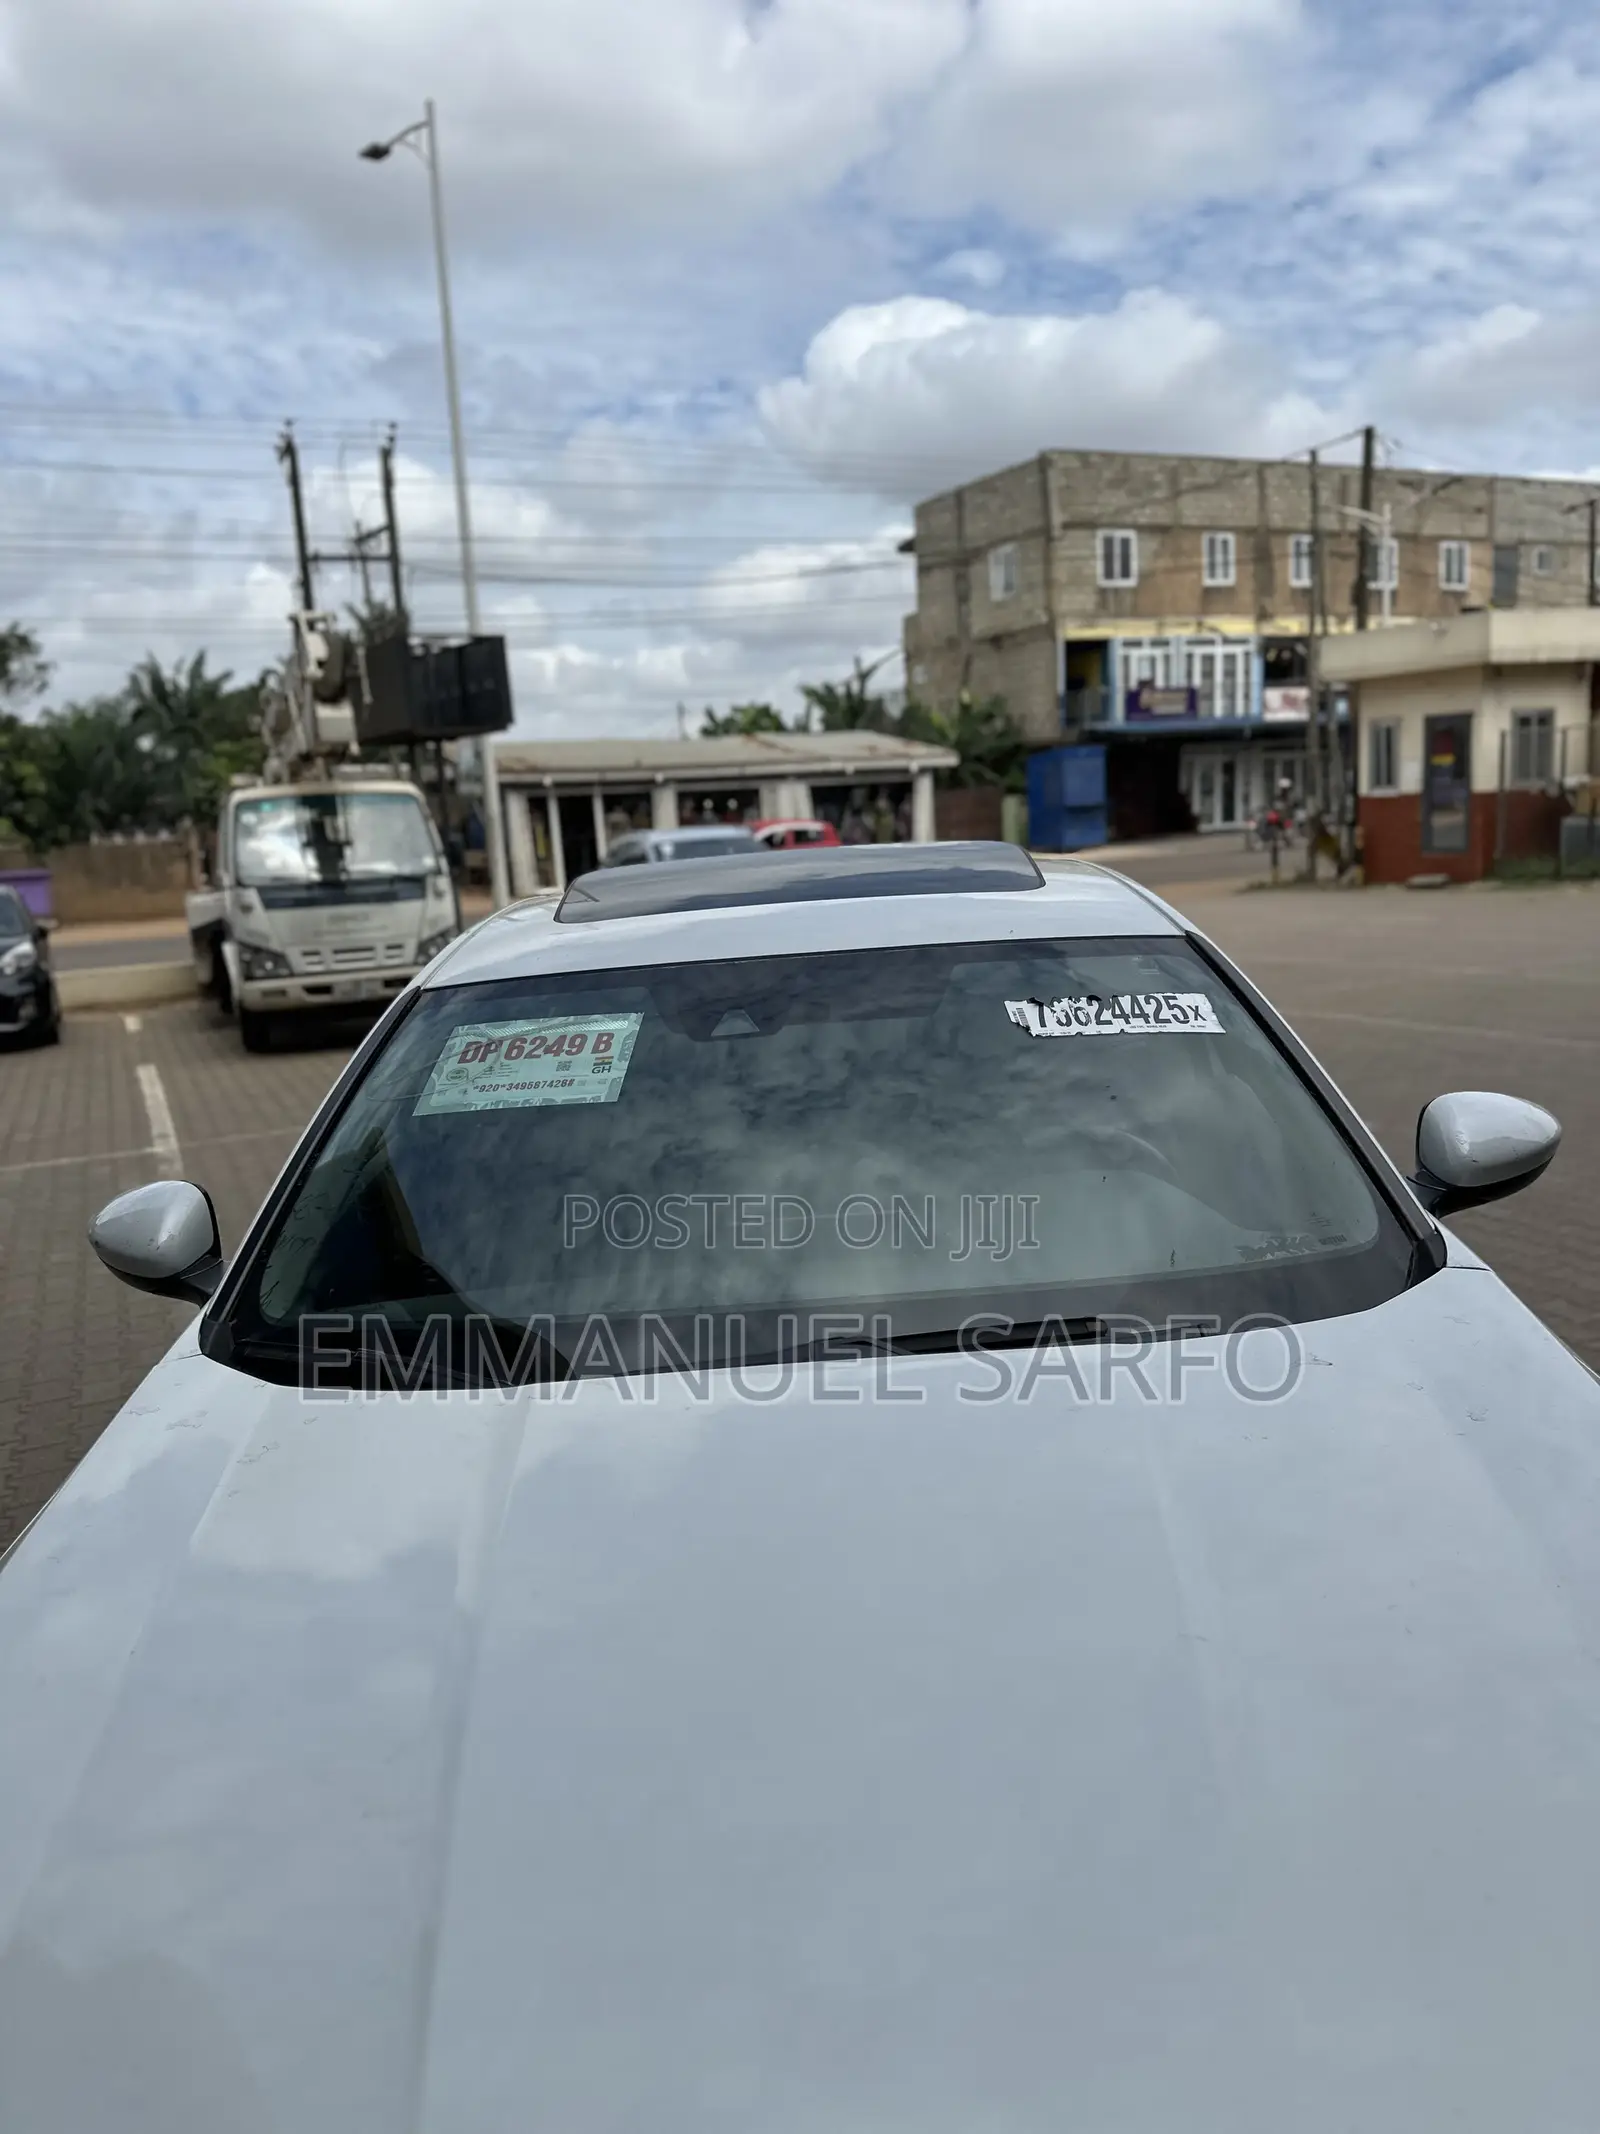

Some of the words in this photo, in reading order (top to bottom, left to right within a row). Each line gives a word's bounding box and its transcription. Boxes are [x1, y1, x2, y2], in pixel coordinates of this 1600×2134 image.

[457, 1039, 503, 1065] DP
[504, 1033, 588, 1061] 6249
[591, 1032, 615, 1055] B
[592, 1065, 612, 1074] GH
